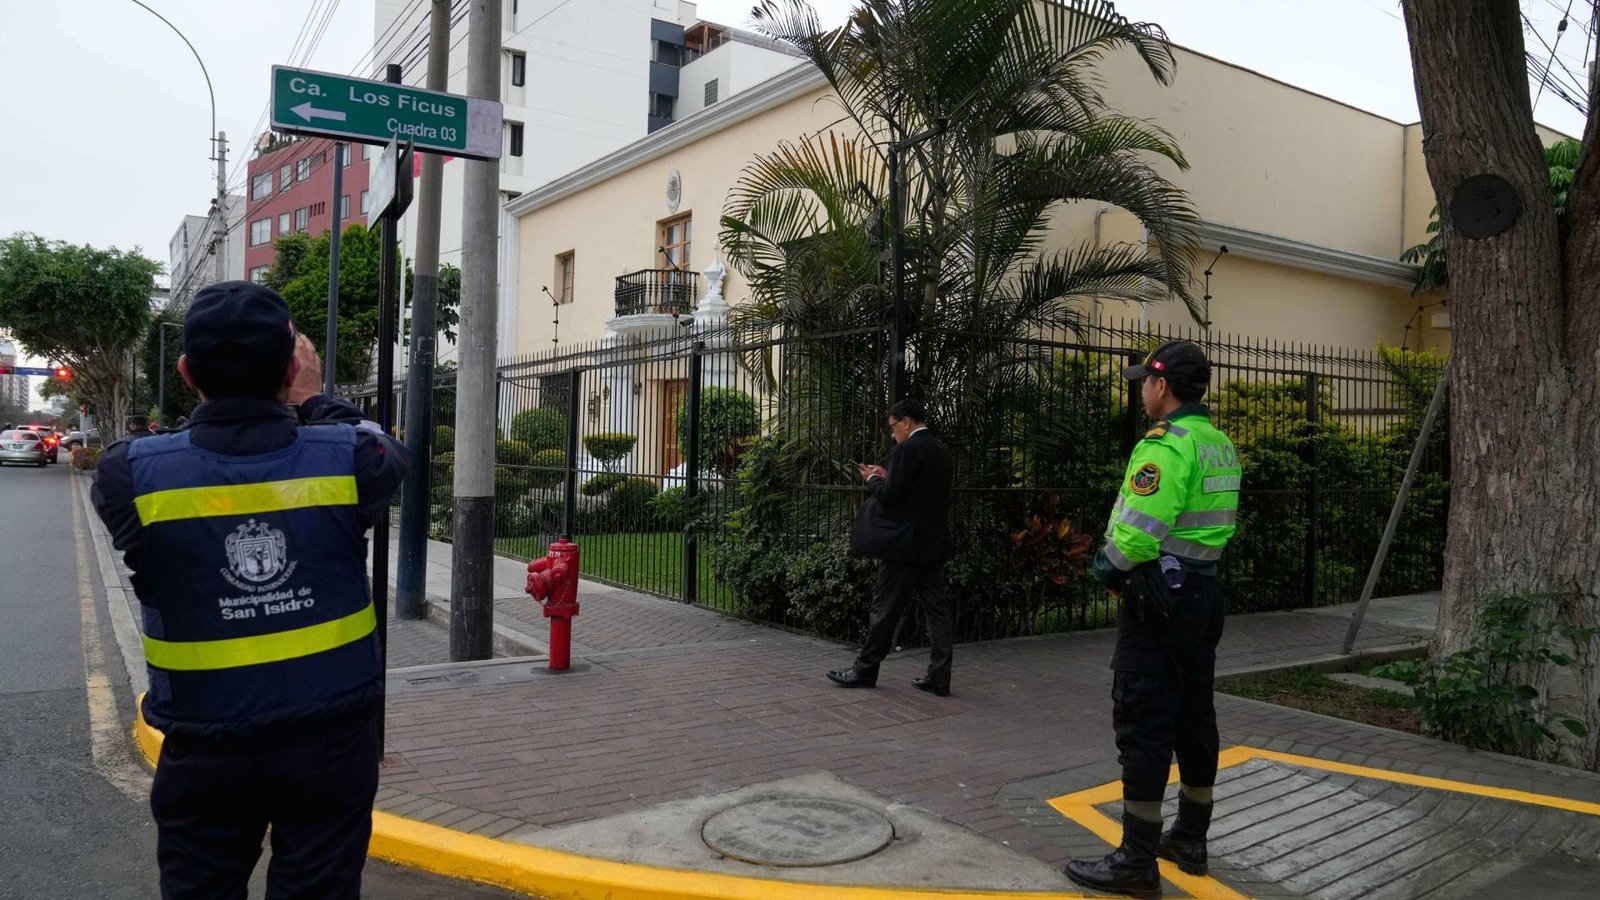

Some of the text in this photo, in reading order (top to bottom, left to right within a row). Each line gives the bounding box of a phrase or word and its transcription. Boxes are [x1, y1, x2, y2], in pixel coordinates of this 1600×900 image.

[289, 77, 456, 117] Ca. Los Ficus
[387, 117, 457, 142] Cuadra 03
[219, 586, 312, 607] Municipalidad de
[221, 598, 315, 620] San Isidro
